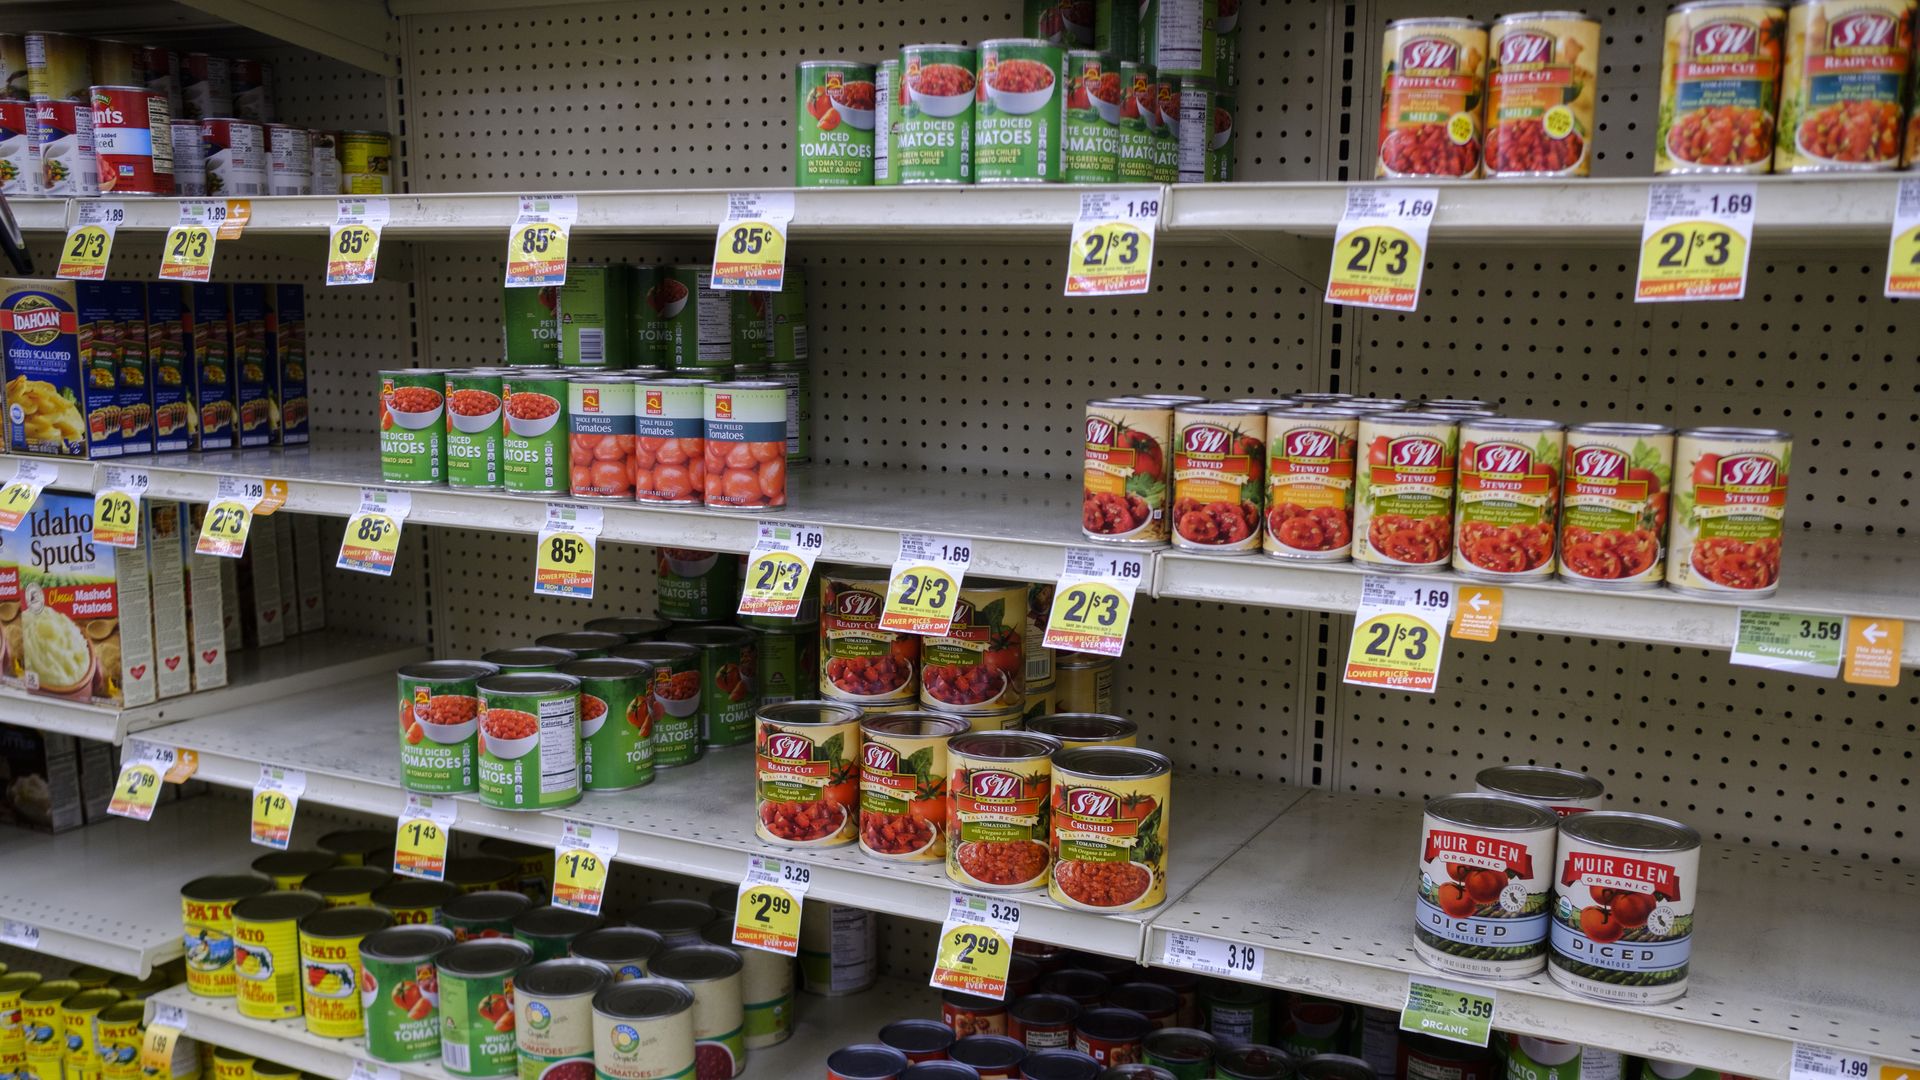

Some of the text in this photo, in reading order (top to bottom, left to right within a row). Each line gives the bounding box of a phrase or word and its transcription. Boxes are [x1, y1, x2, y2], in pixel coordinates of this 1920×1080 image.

[923, 121, 955, 132] DICED
[1000, 118, 1032, 130] DICED
[820, 132, 850, 142] DICED
[800, 144, 872, 158] TOMATOES
[1128, 200, 1158, 217] 1.69
[1398, 200, 1433, 217] 1.69
[1710, 194, 1752, 214] 1.69
[576, 423, 612, 433] Tomatoes
[640, 426, 674, 436] Tomatoes
[708, 430, 744, 440] Tomatoes
[30, 508, 94, 538] Idaho
[796, 532, 822, 548] 1.69
[31, 536, 96, 574] Spuds
[942, 545, 970, 562] 1.69
[1110, 560, 1140, 578] 1.69
[1414, 588, 1450, 608] 1.69
[934, 622, 948, 630] DAY
[1800, 620, 1842, 640] 3.59
[1348, 670, 1409, 678] LOWER PRICES
[1415, 676, 1432, 684] DAY
[401, 755, 462, 769] TOMATOES
[974, 802, 1018, 814] CRUSHED
[1070, 820, 1114, 833] CRUSHED
[1432, 834, 1520, 862] MUIR GLEN
[1443, 854, 1501, 869] ORGANIC
[784, 866, 810, 883] 3.29
[1574, 858, 1668, 884] MUIR GLEN
[1586, 876, 1649, 892] ORGANIC
[991, 904, 1020, 922] 3.29
[1432, 913, 1508, 936] DICED
[1447, 932, 1485, 944] TOMATOES
[1228, 944, 1256, 971] 3.19
[1572, 938, 1654, 962] DICED
[1590, 956, 1632, 970] TOMATOES
[966, 982, 988, 990] EVERY
[1458, 996, 1493, 1019] 3.59
[1421, 1018, 1469, 1036] ORGANIC
[1840, 1058, 1868, 1078] 1.99
